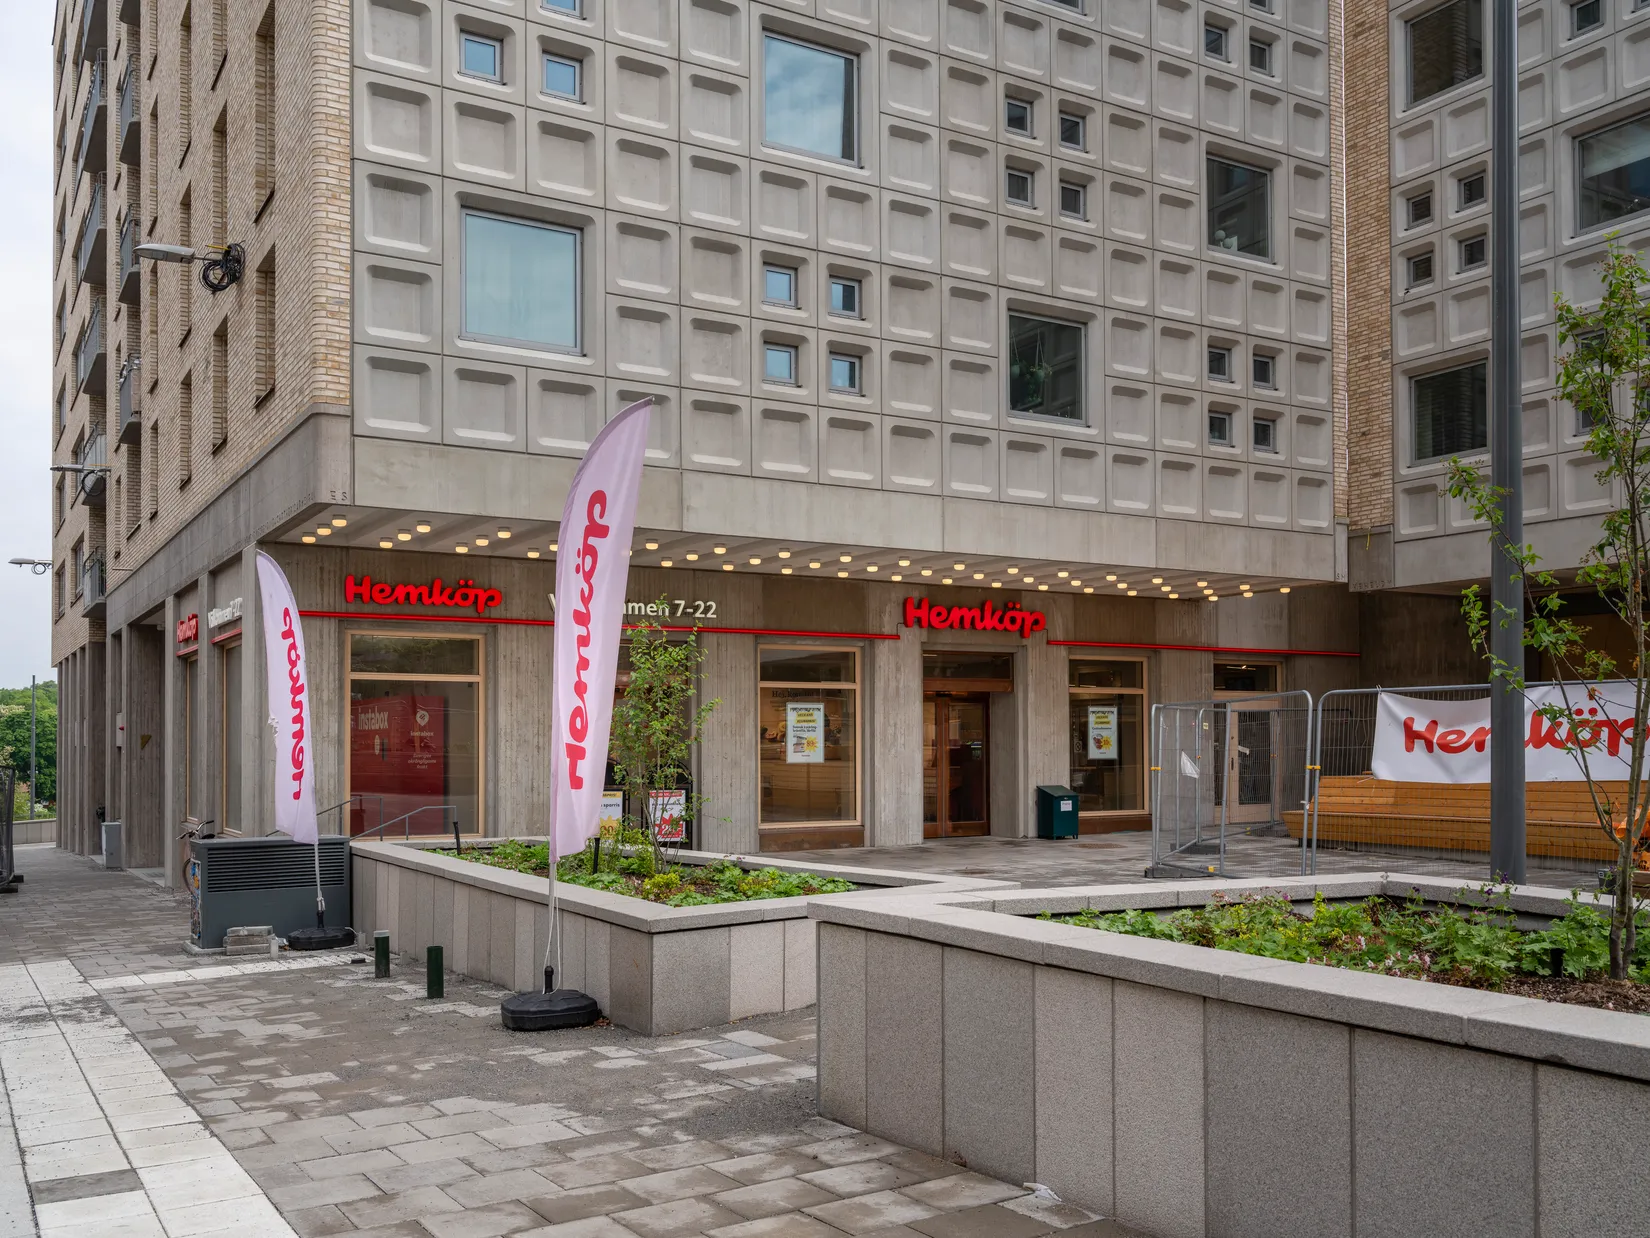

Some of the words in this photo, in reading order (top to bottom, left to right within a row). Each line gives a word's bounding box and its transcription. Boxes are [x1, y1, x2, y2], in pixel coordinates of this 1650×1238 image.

[345, 573, 503, 613] Hemköp
[674, 600, 718, 618] 7-22
[904, 596, 1046, 639] Hemköp
[565, 489, 610, 791] Hemköp
[358, 706, 389, 730] instabox
[1404, 707, 1650, 758] Heköp
